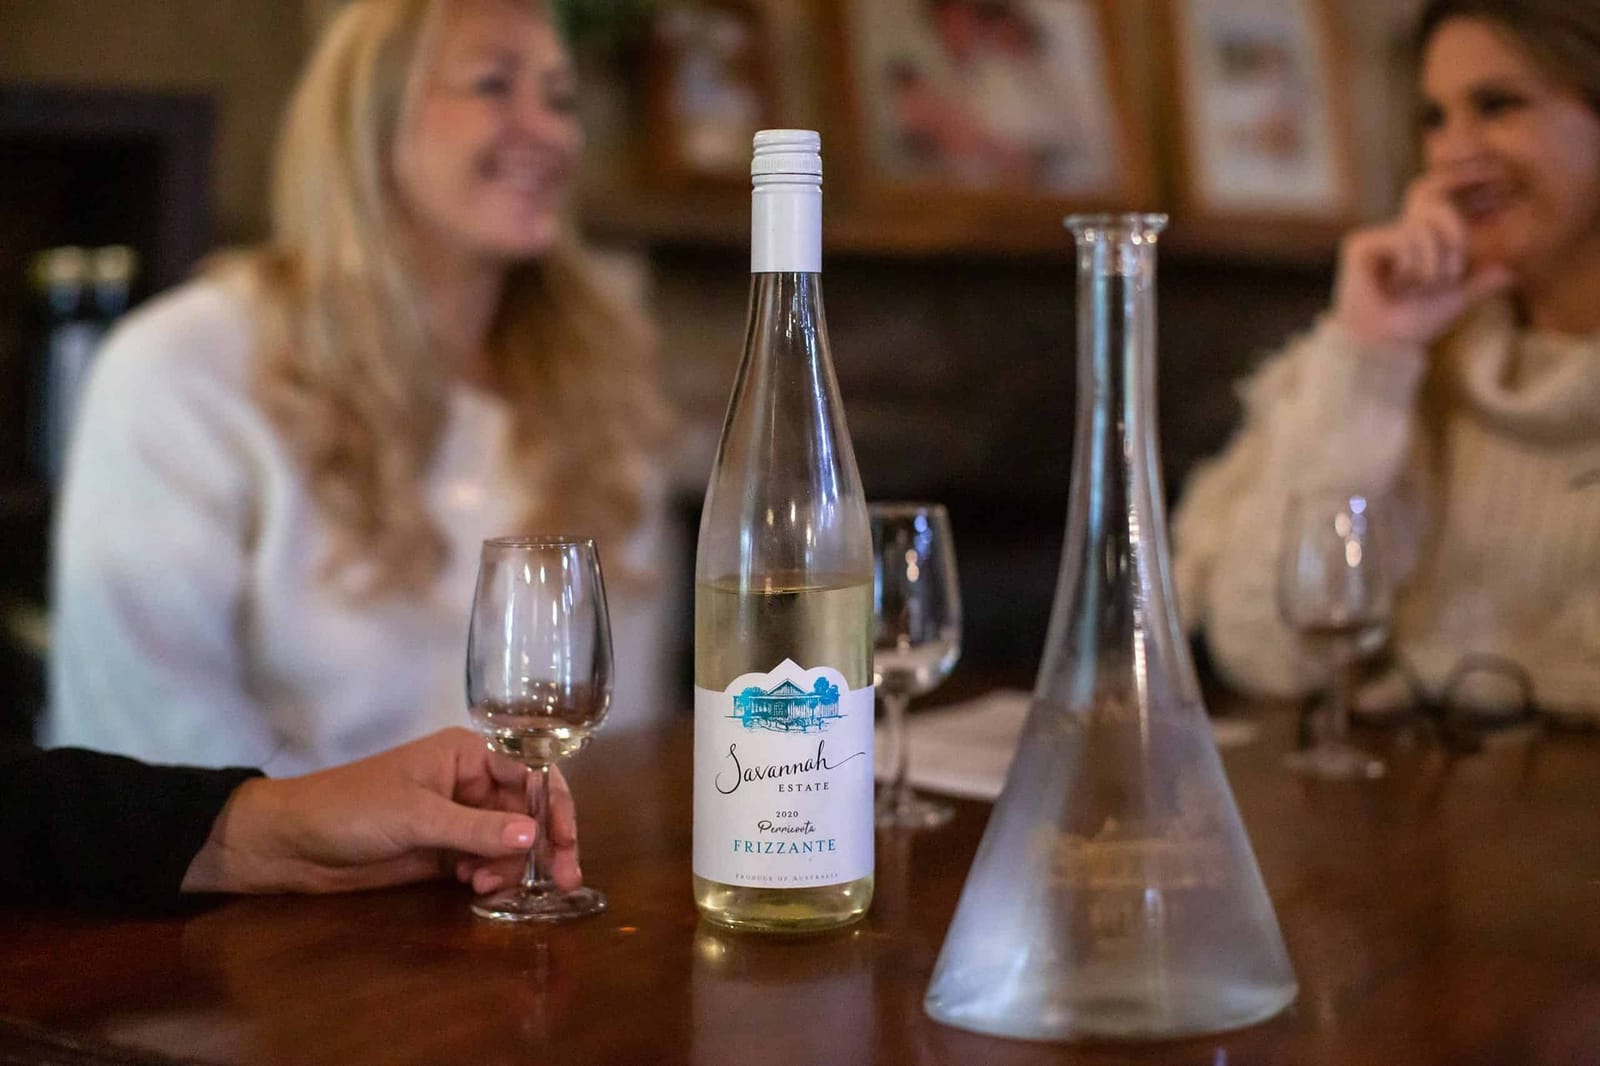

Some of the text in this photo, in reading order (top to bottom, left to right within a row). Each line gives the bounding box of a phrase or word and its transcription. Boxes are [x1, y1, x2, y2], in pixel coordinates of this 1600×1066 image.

[715, 739, 865, 794] Savannah
[778, 782, 829, 792] ESTATE
[775, 810, 799, 818] 2020
[733, 839, 836, 854] FRIZZANTE
